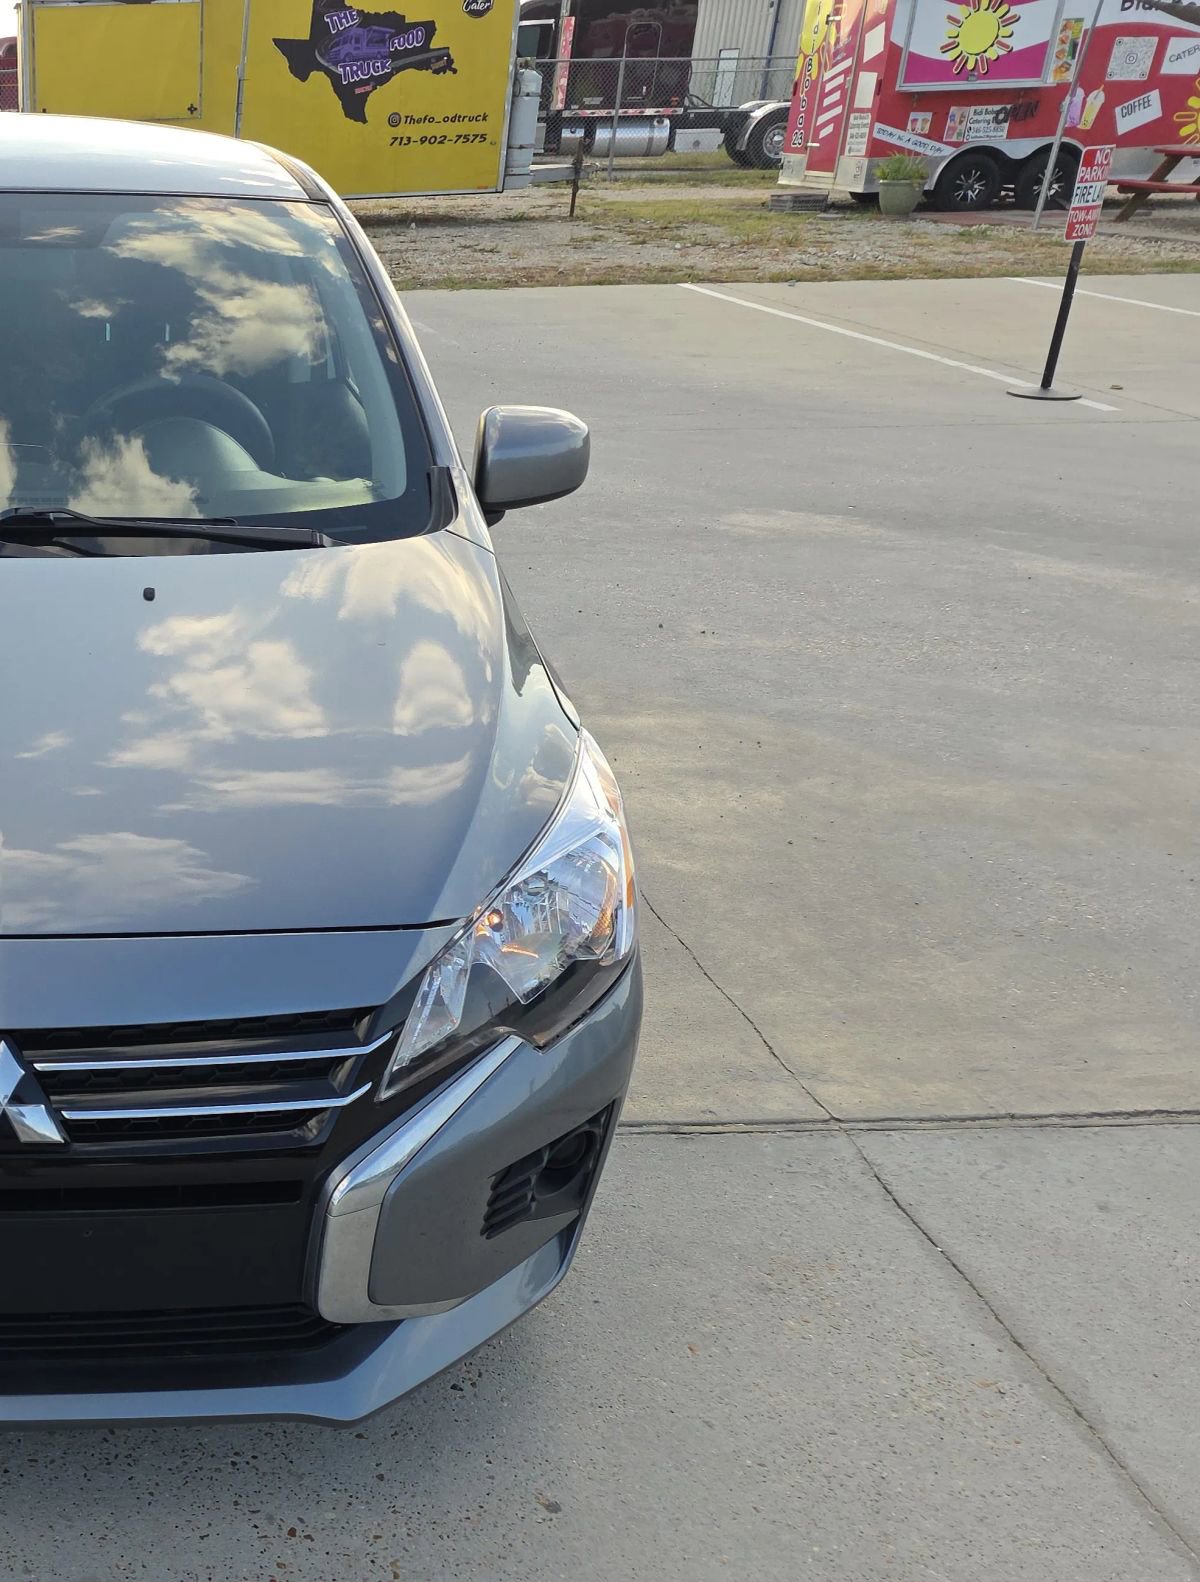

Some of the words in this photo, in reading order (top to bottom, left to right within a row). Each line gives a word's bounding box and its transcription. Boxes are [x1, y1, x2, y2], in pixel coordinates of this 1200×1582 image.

[324, 9, 360, 34] THE
[390, 26, 425, 51] FOOD
[338, 59, 392, 85] TRUCK
[797, 57, 813, 127] Boba
[1121, 94, 1152, 119] COFFEE
[969, 117, 991, 126] Catering
[389, 133, 488, 147] 713-902-7575
[791, 130, 805, 148] 23
[1094, 149, 1111, 165] NO
[1072, 184, 1093, 205] FIRE
